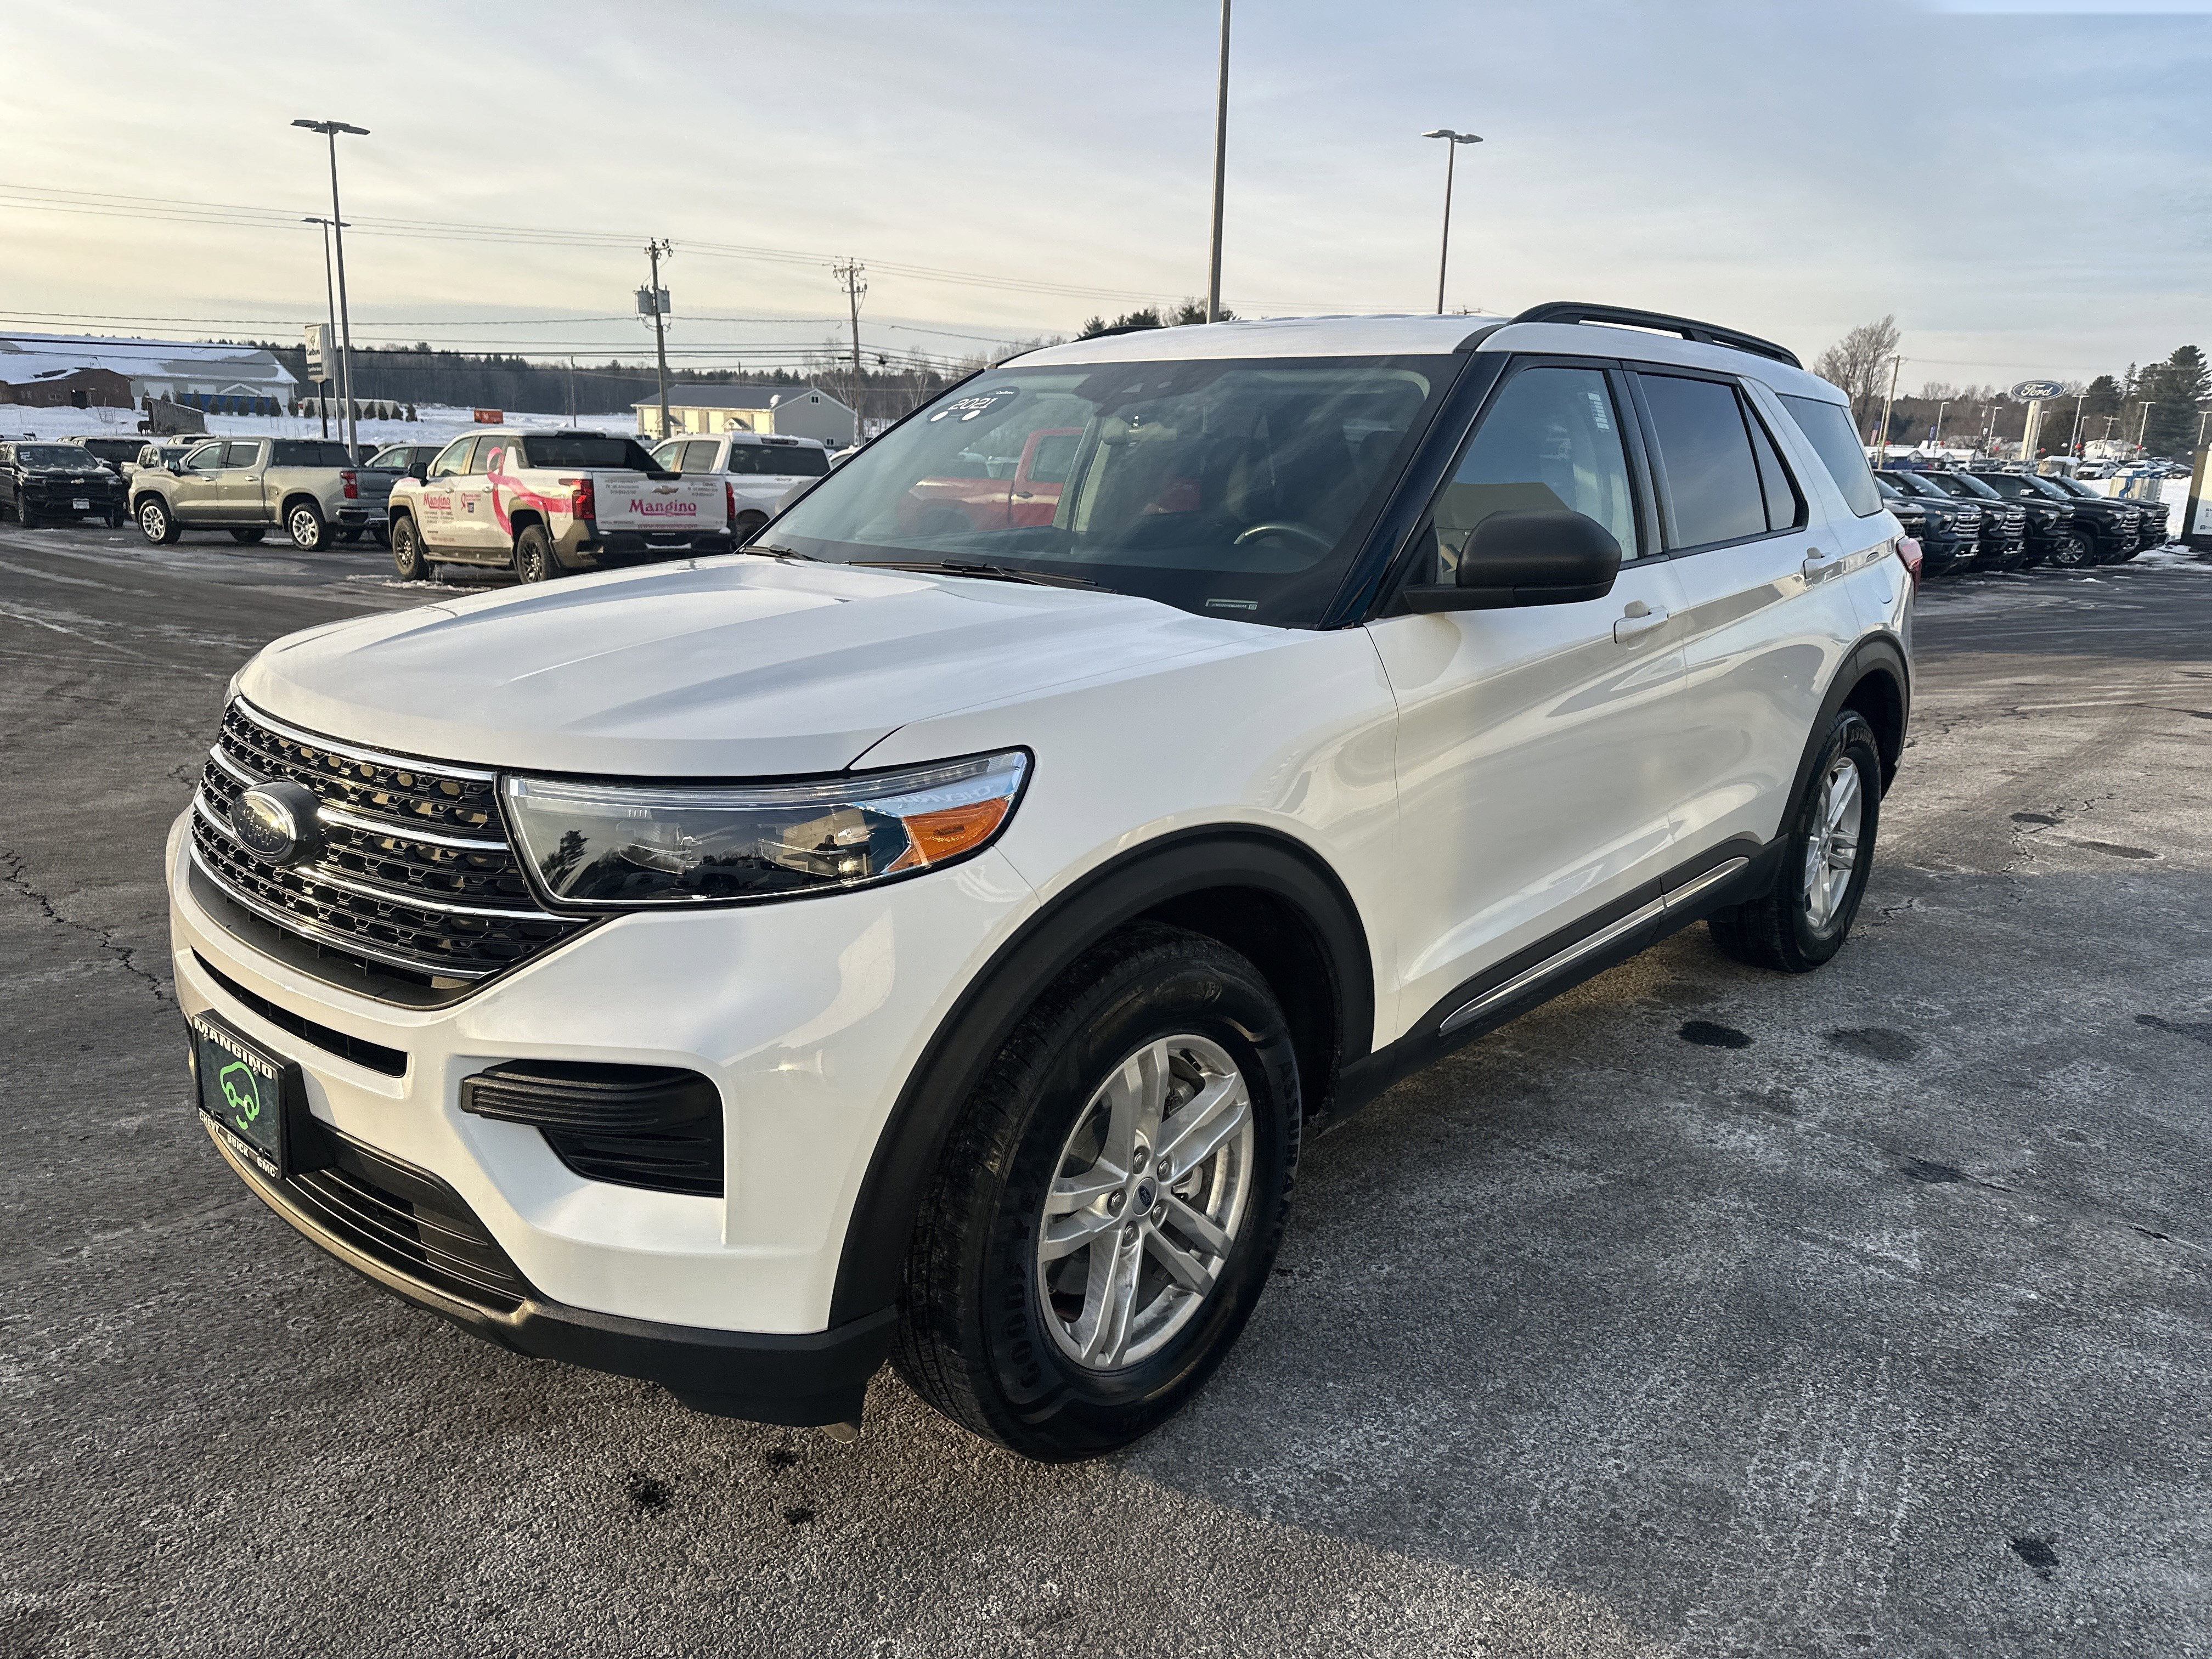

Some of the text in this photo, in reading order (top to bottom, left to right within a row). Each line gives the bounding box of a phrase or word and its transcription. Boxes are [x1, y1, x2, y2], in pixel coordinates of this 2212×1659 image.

[2021, 384, 2053, 396] Ford
[947, 397, 998, 410] 2021
[424, 493, 452, 510] Mangino
[629, 499, 697, 517] Mangino
[194, 1018, 273, 1080] MANGINO
[199, 1111, 220, 1134] CHEVY
[227, 1133, 249, 1158] BUICK
[257, 1156, 276, 1178] GMC
